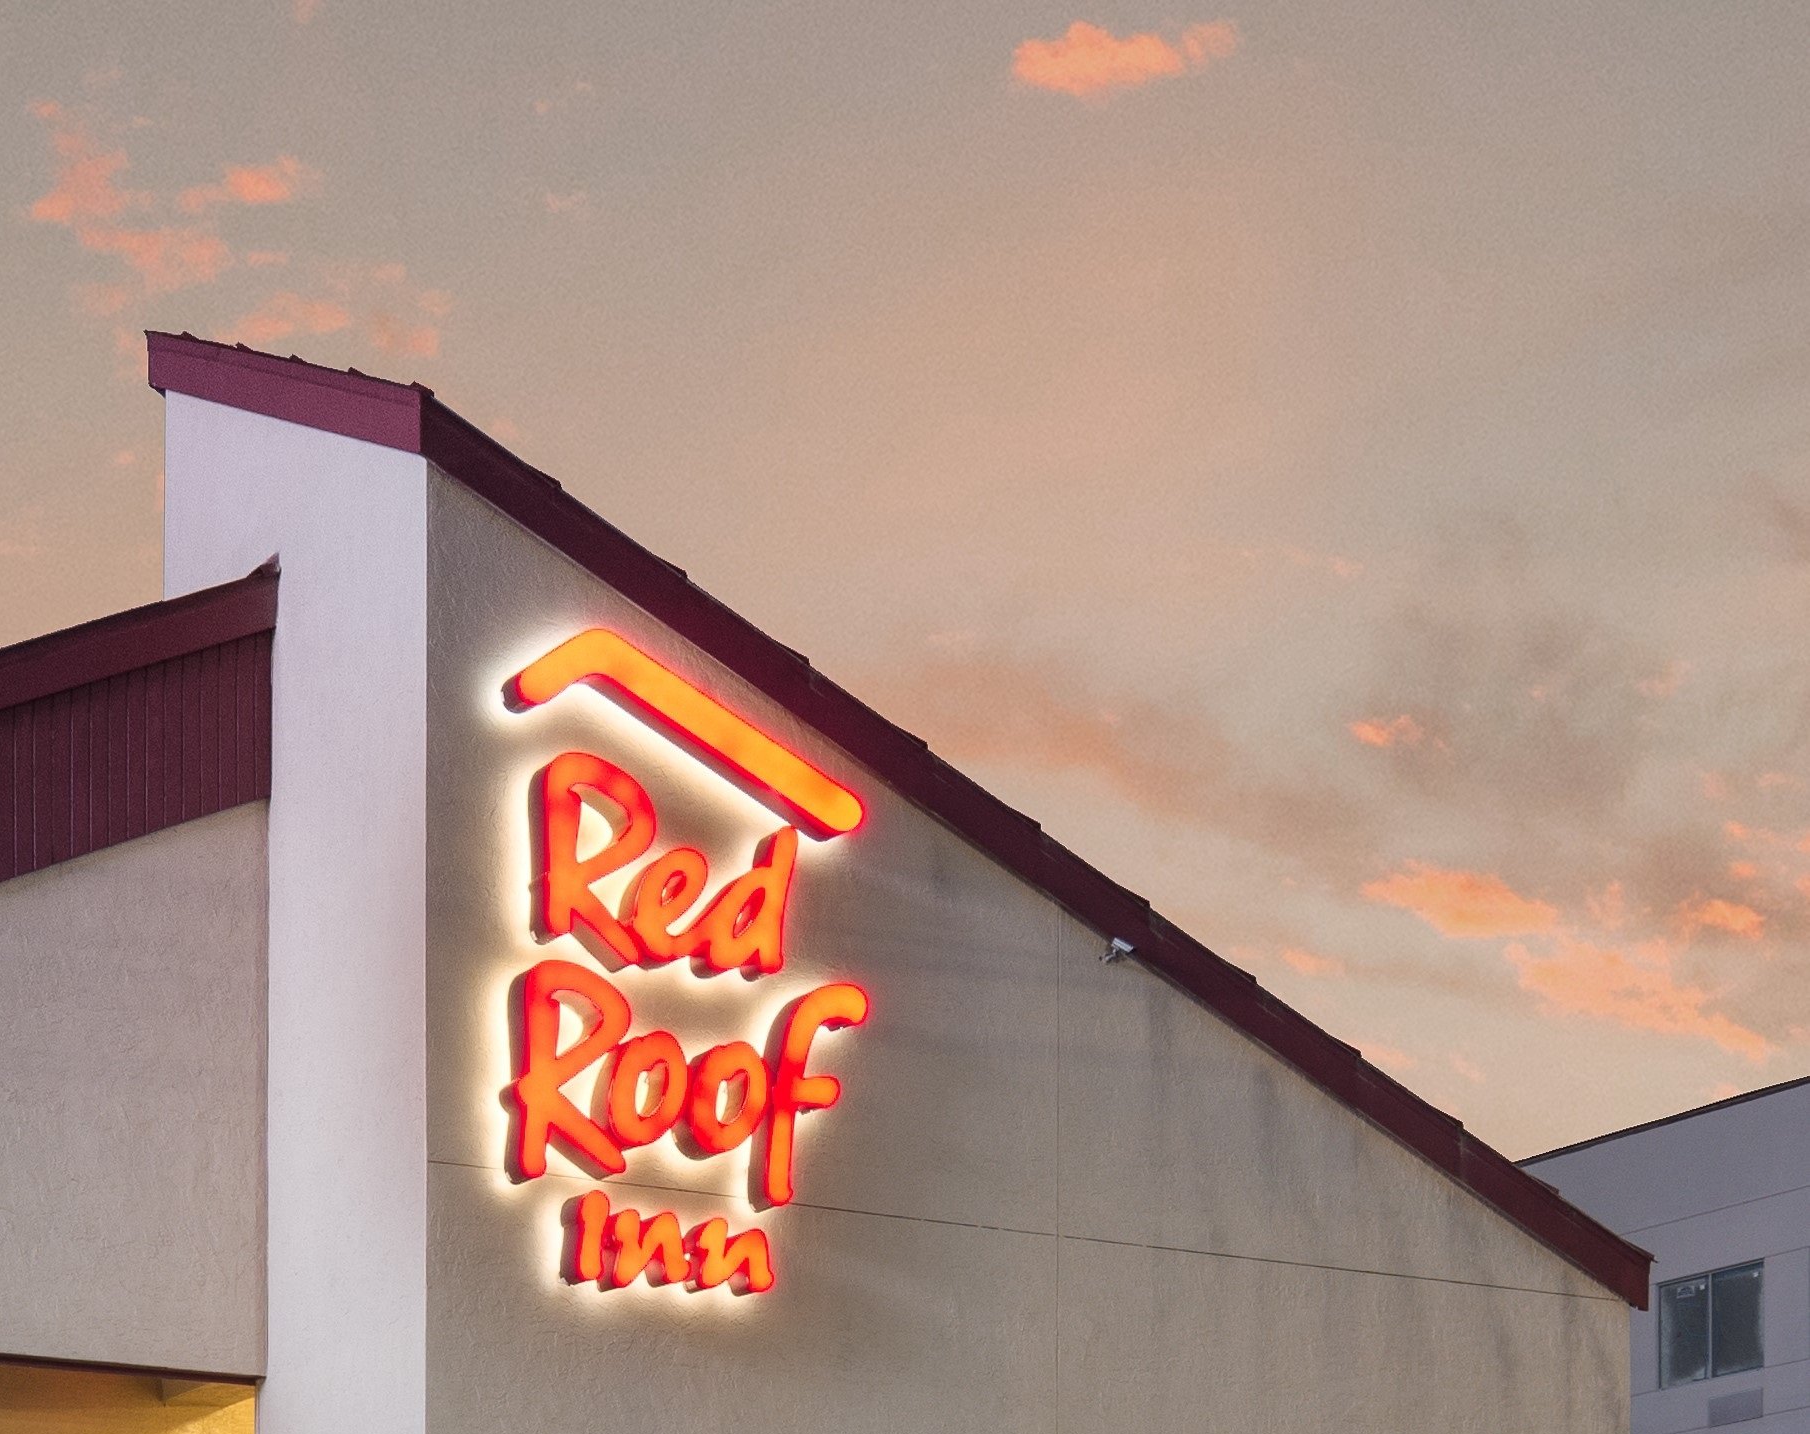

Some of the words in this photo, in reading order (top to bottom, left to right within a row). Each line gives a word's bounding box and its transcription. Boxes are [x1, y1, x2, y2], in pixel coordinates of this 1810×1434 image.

[530, 752, 798, 978] Red
[500, 960, 869, 1210] Roof
[561, 1190, 775, 1295] Inn
